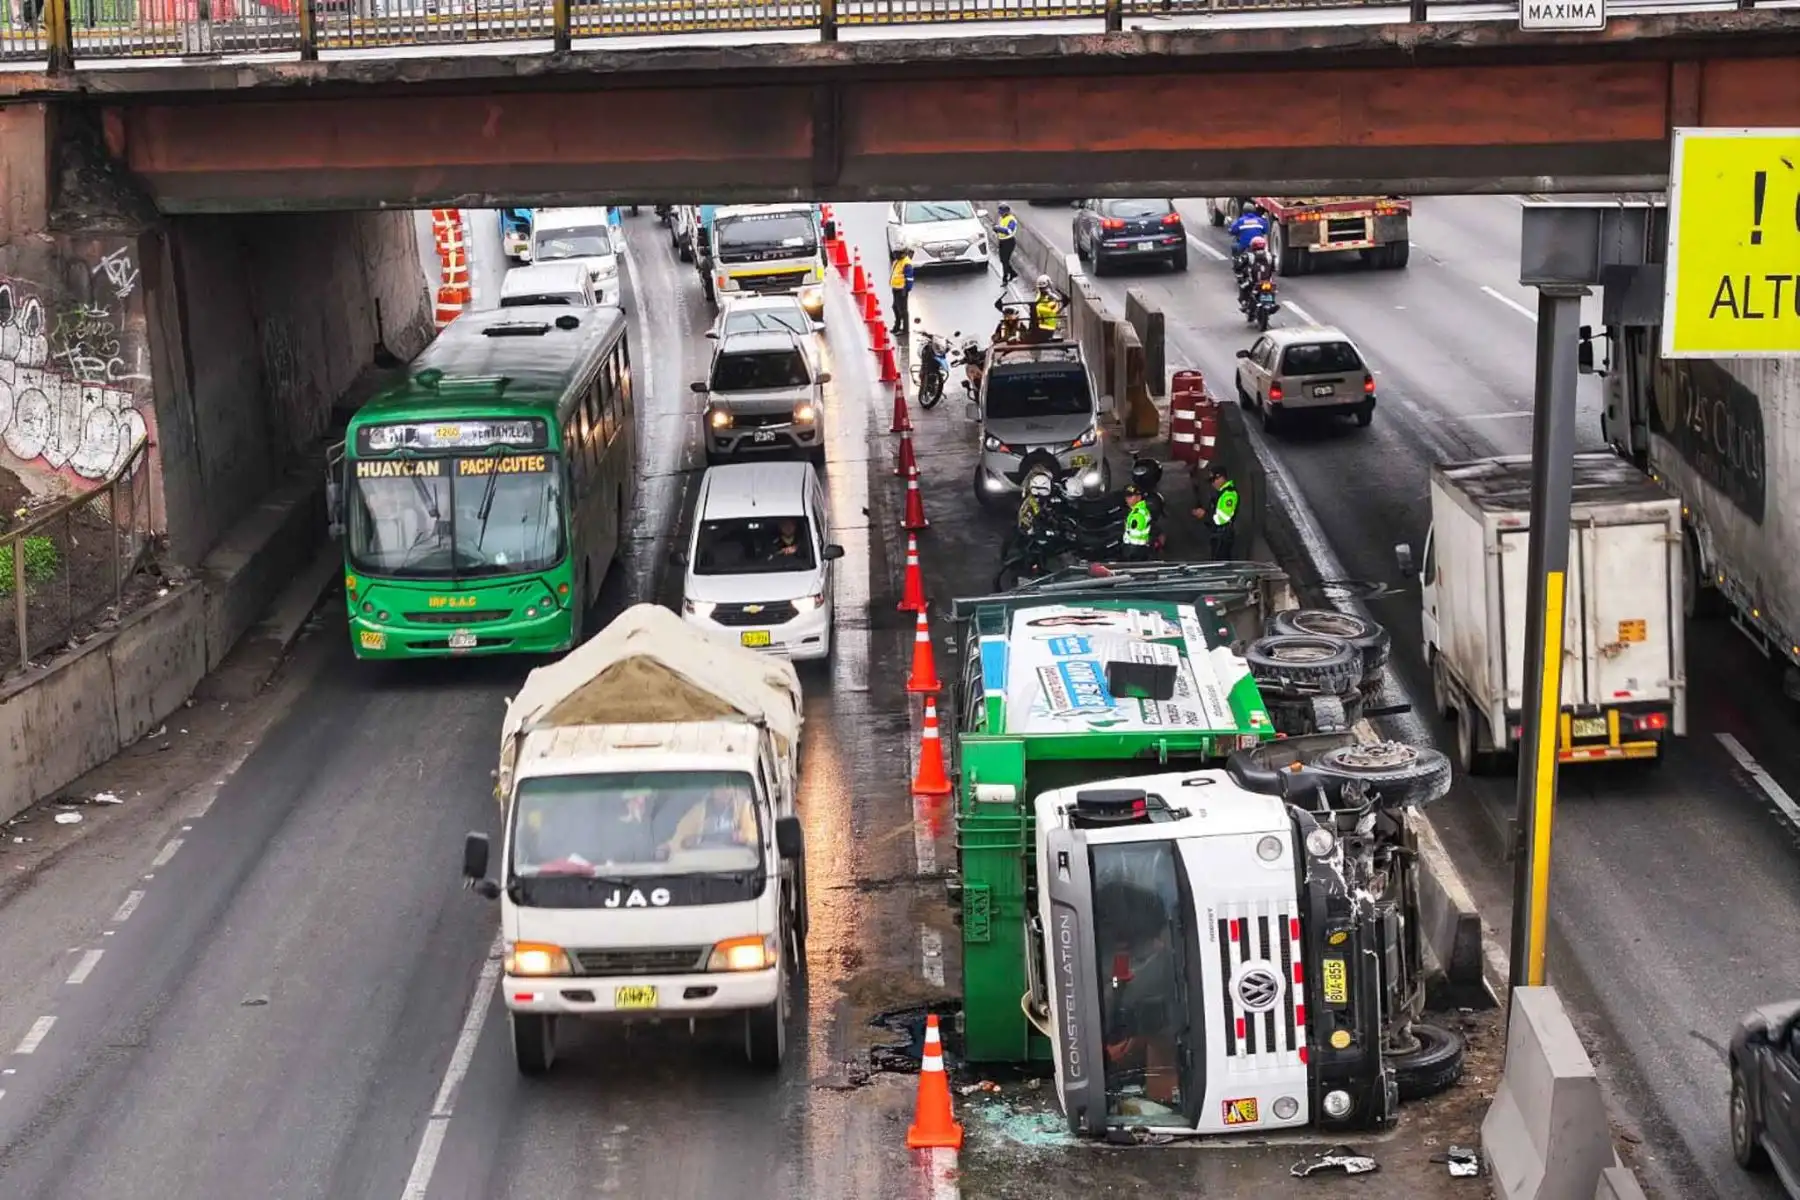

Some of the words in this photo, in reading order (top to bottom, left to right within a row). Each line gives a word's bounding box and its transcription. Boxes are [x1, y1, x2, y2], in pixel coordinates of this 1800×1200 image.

[1529, 3, 1597, 19] MAXIMA
[1708, 274, 1800, 320] ALT
[357, 461, 440, 477] HUAYCAN
[604, 887, 671, 908] JAC
[1060, 915, 1081, 1078] CONSTELLATION
